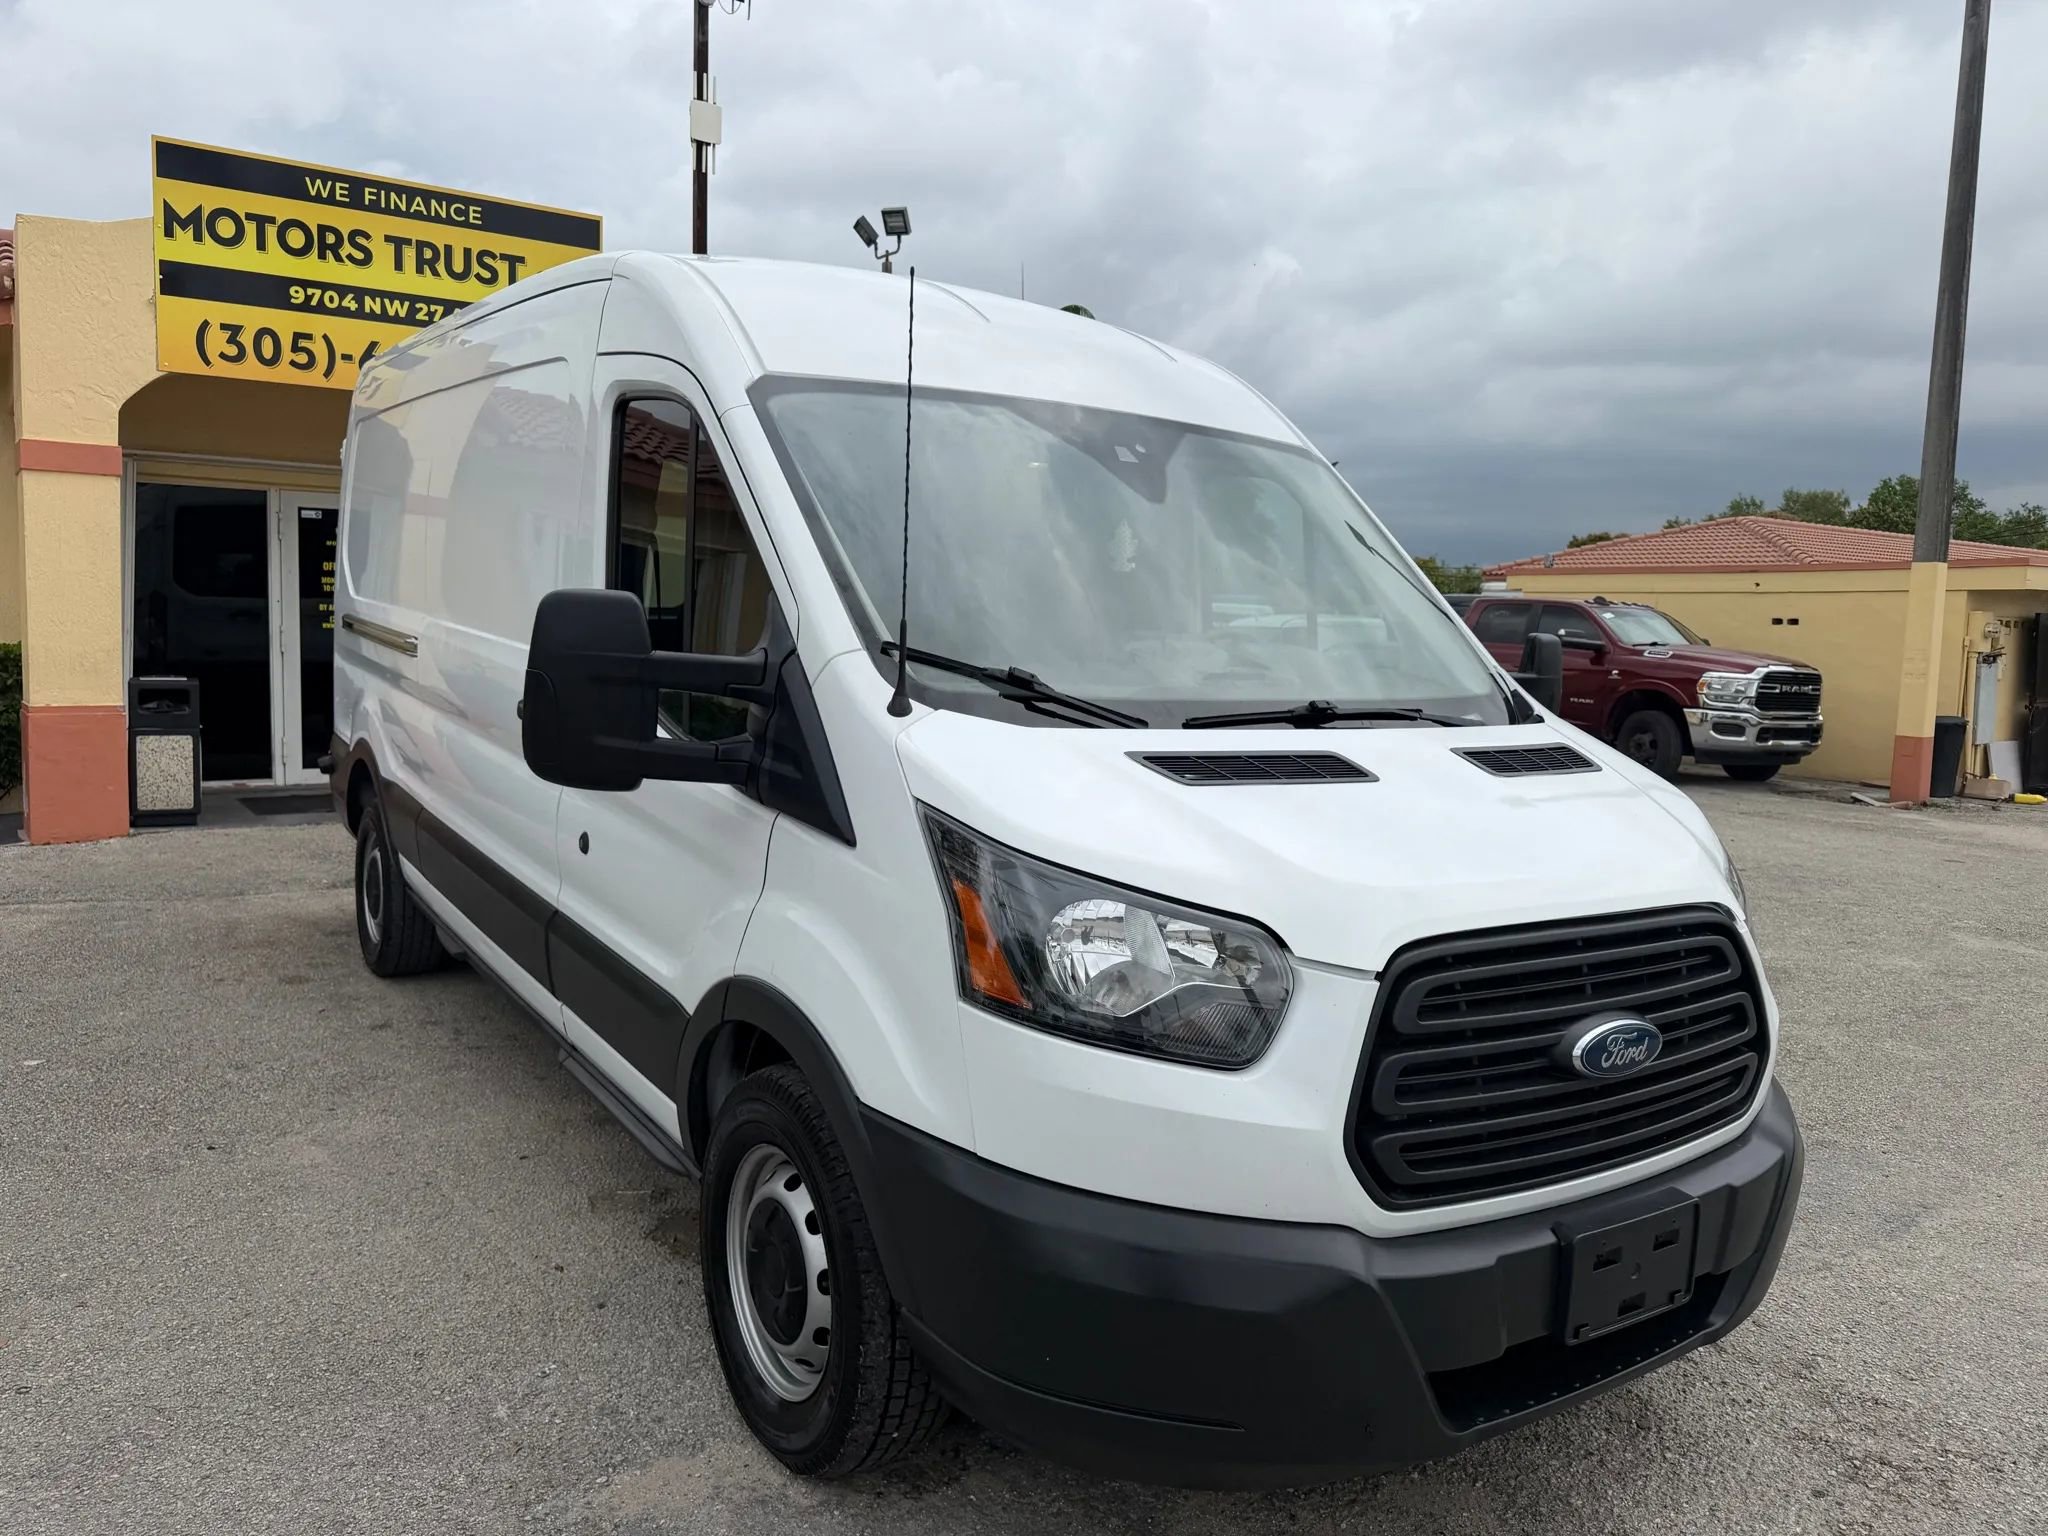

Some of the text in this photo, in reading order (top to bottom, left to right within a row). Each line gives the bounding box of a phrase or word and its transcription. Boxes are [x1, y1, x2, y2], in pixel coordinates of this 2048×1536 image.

[304, 176, 483, 225] WE FINANCE
[163, 197, 528, 288] MOTORS TRUST
[288, 285, 445, 323] 9704 NW 27
[1781, 684, 1809, 694] RAM
[1601, 1031, 1649, 1069] Ford
